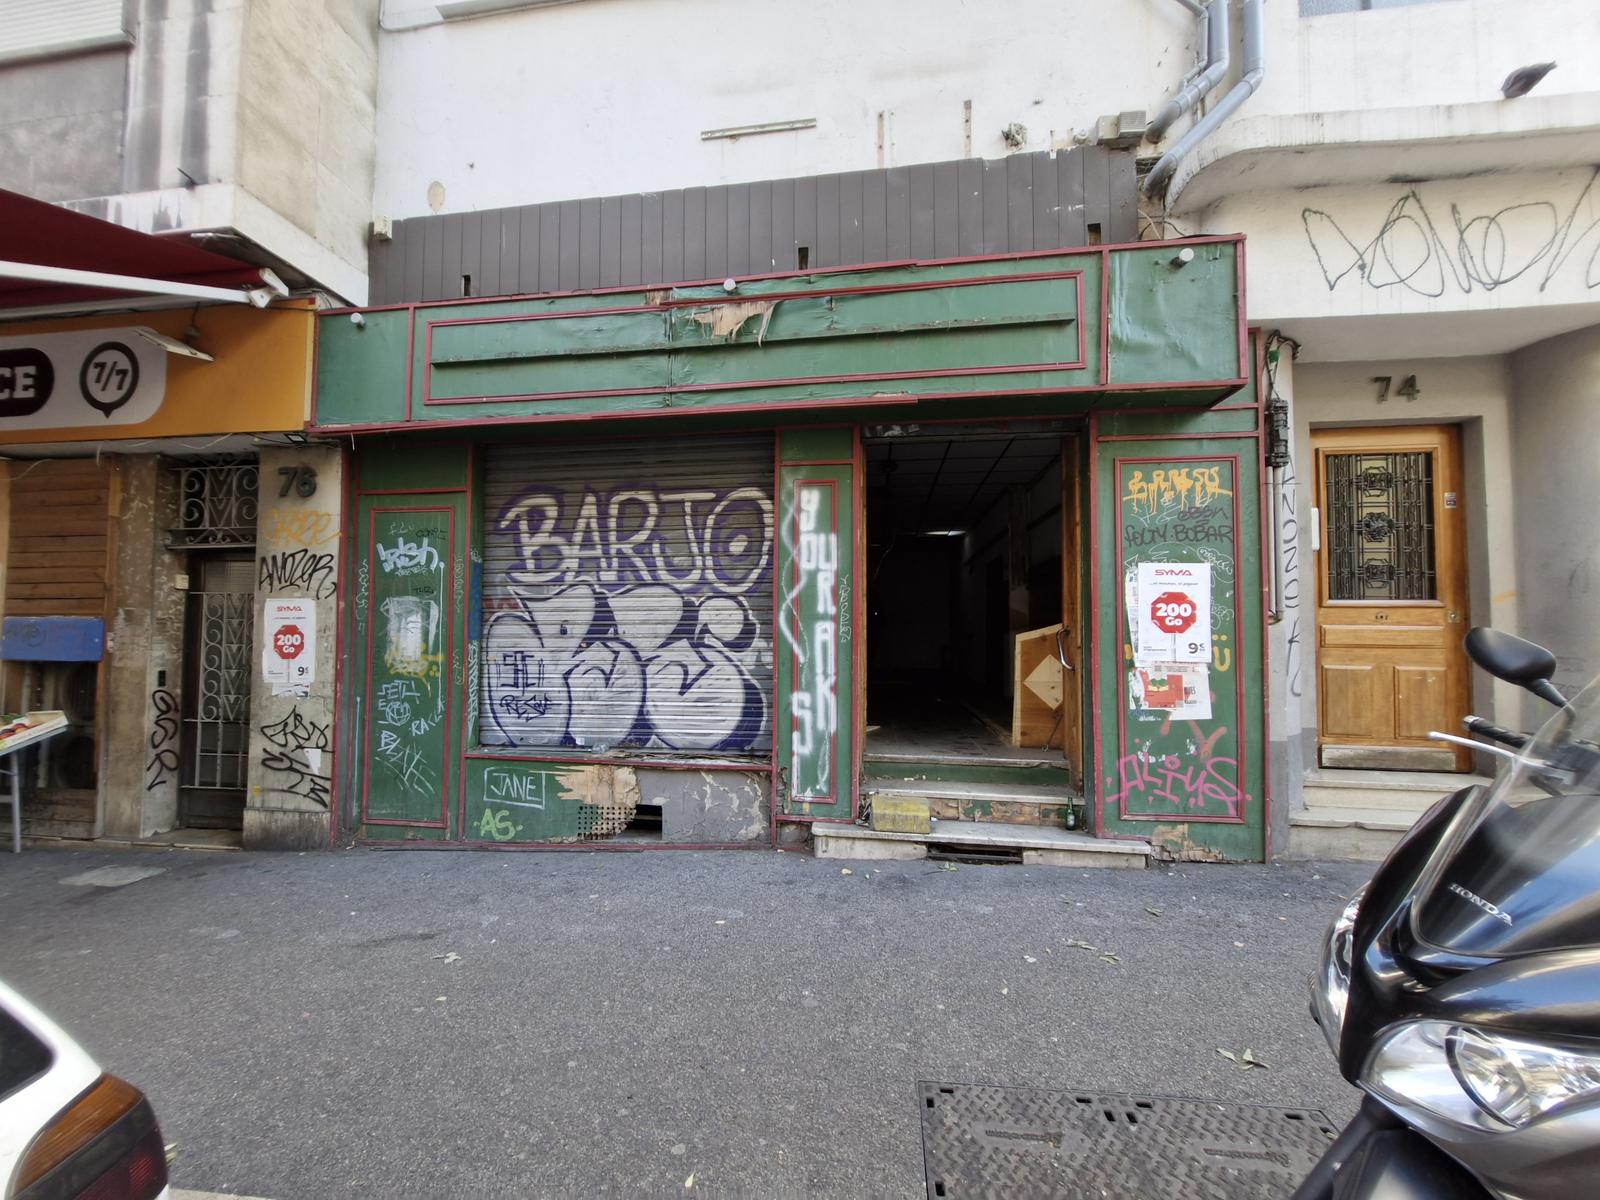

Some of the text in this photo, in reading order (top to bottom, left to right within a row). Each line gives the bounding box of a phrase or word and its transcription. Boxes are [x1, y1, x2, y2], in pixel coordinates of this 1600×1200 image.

[93, 361, 129, 391] 7/7
[1373, 374, 1421, 402] 74
[277, 466, 318, 498] 76
[1154, 568, 1193, 577] SYMA
[1155, 602, 1193, 618] 200
[1164, 616, 1184, 627] Go
[276, 634, 302, 646] 200
[282, 645, 295, 653] Go
[490, 772, 537, 801] JANE
[1449, 882, 1514, 927] HONDA
